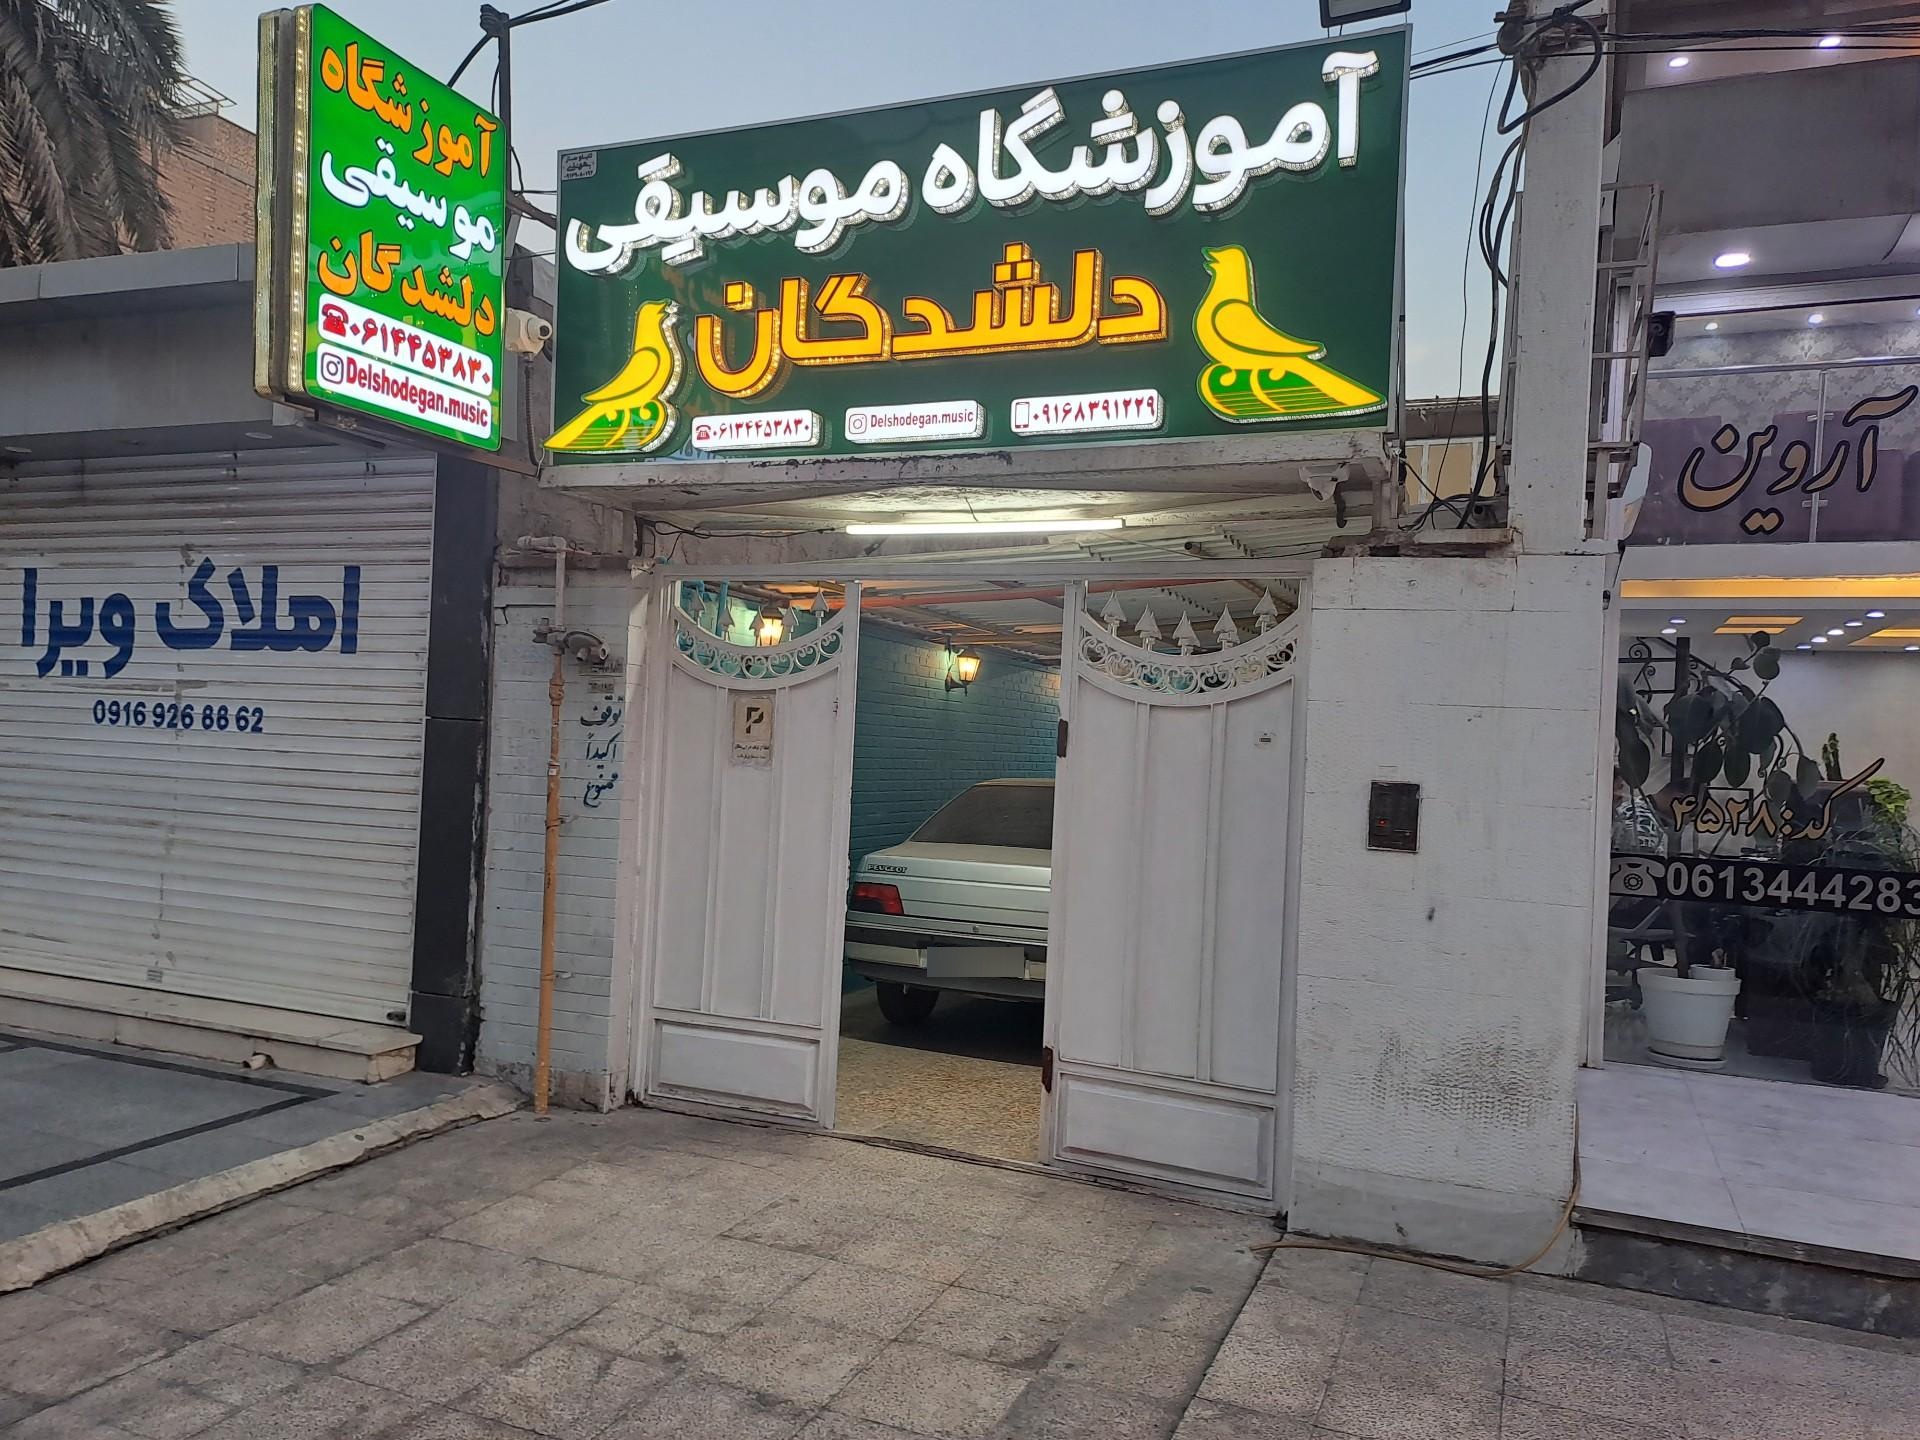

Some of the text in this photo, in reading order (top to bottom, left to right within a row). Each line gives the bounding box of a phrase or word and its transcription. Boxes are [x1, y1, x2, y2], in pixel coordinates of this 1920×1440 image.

[320, 41, 497, 178] آموزشگاه
[320, 137, 496, 261] موسیقی
[564, 50, 1380, 277] آموزشگاه موسیقی
[317, 230, 496, 336] دلشدگان
[694, 242, 1168, 399] دلشدگان
[345, 356, 488, 428] Delshodegan.music
[870, 408, 974, 428] Delshodegan.music
[1033, 395, 1155, 424] ۰۹۱۶۸۳۹۱۲۲۹
[713, 418, 809, 440] ۰۶۱۳۴۴۵۳۸۳۰
[1677, 384, 1919, 535] آروین
[21, 556, 361, 679] املاک ویرا
[92, 699, 264, 733] 0916 926 88 62
[580, 695, 624, 727] توقف
[867, 863, 907, 874] PEUGEOT
[1666, 861, 1920, 916] 0613444283
